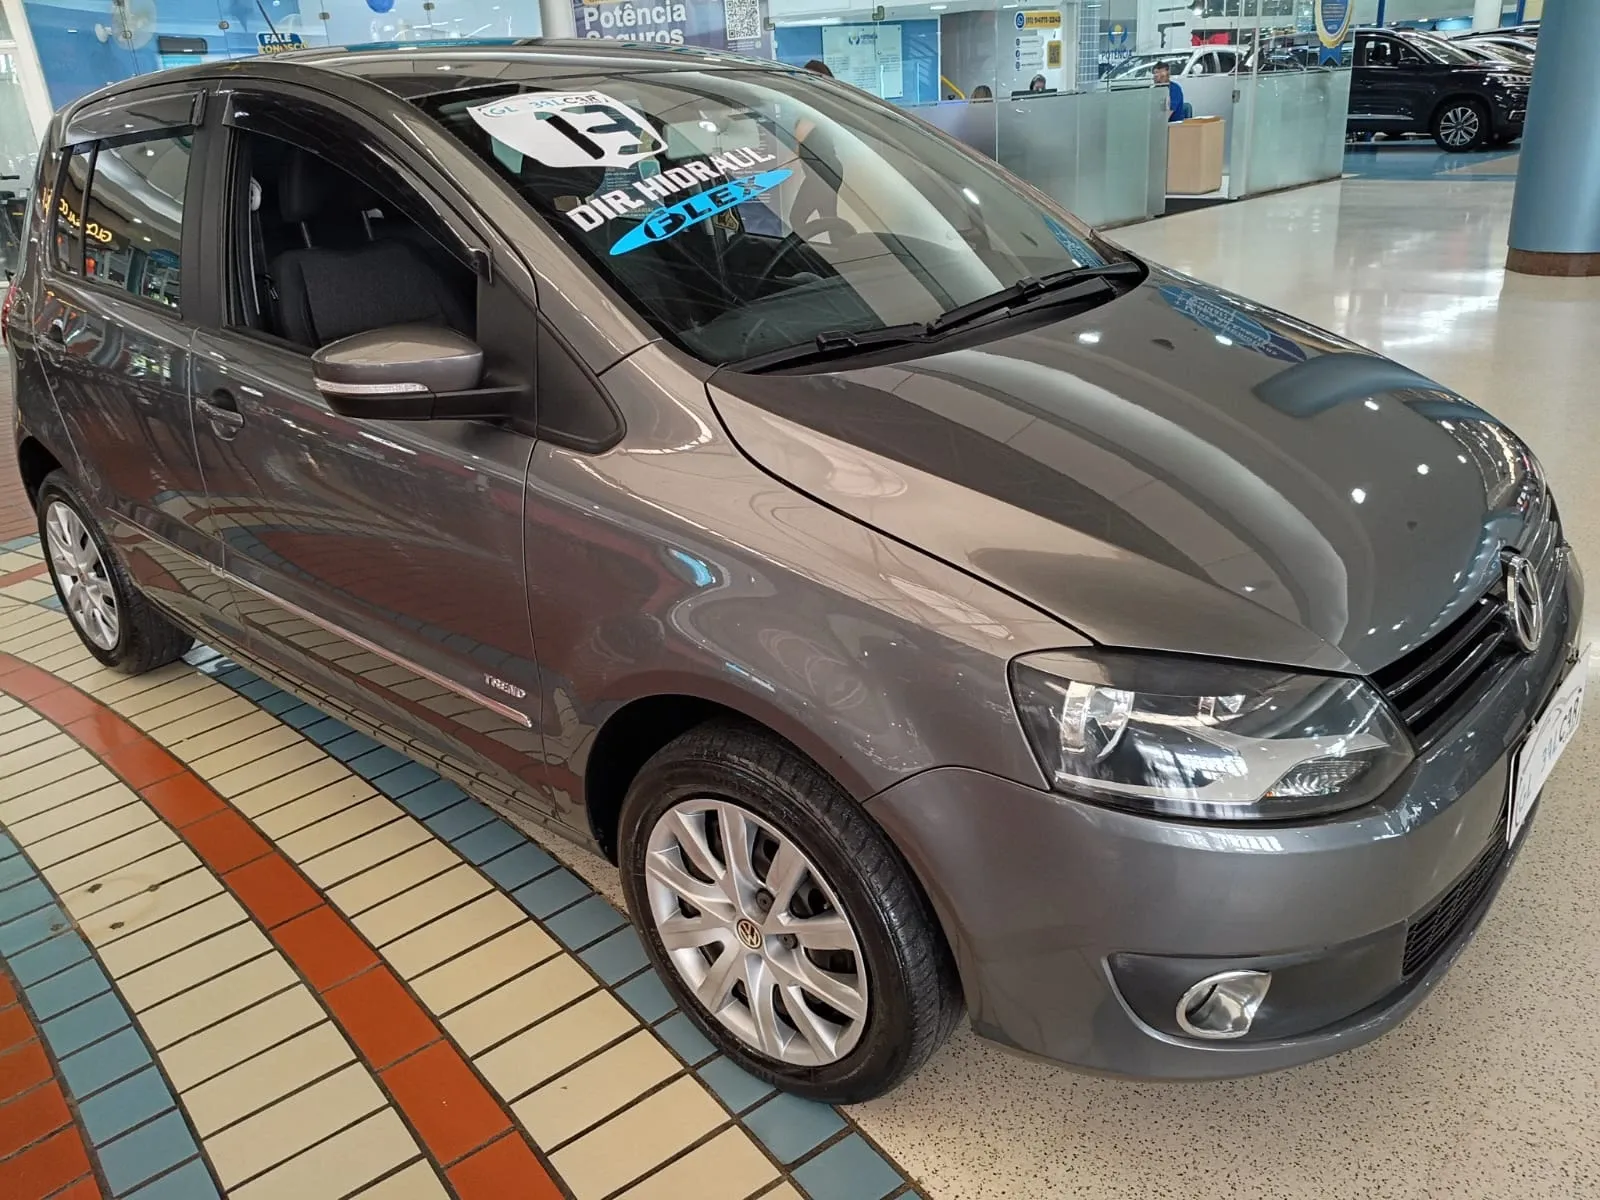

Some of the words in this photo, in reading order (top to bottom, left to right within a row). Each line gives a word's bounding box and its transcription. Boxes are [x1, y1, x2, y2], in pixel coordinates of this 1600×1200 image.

[583, 2, 687, 30] Potência
[263, 34, 292, 44] FALE
[586, 28, 685, 45] uros
[645, 175, 768, 238] FLEX
[484, 672, 526, 698] TREND
